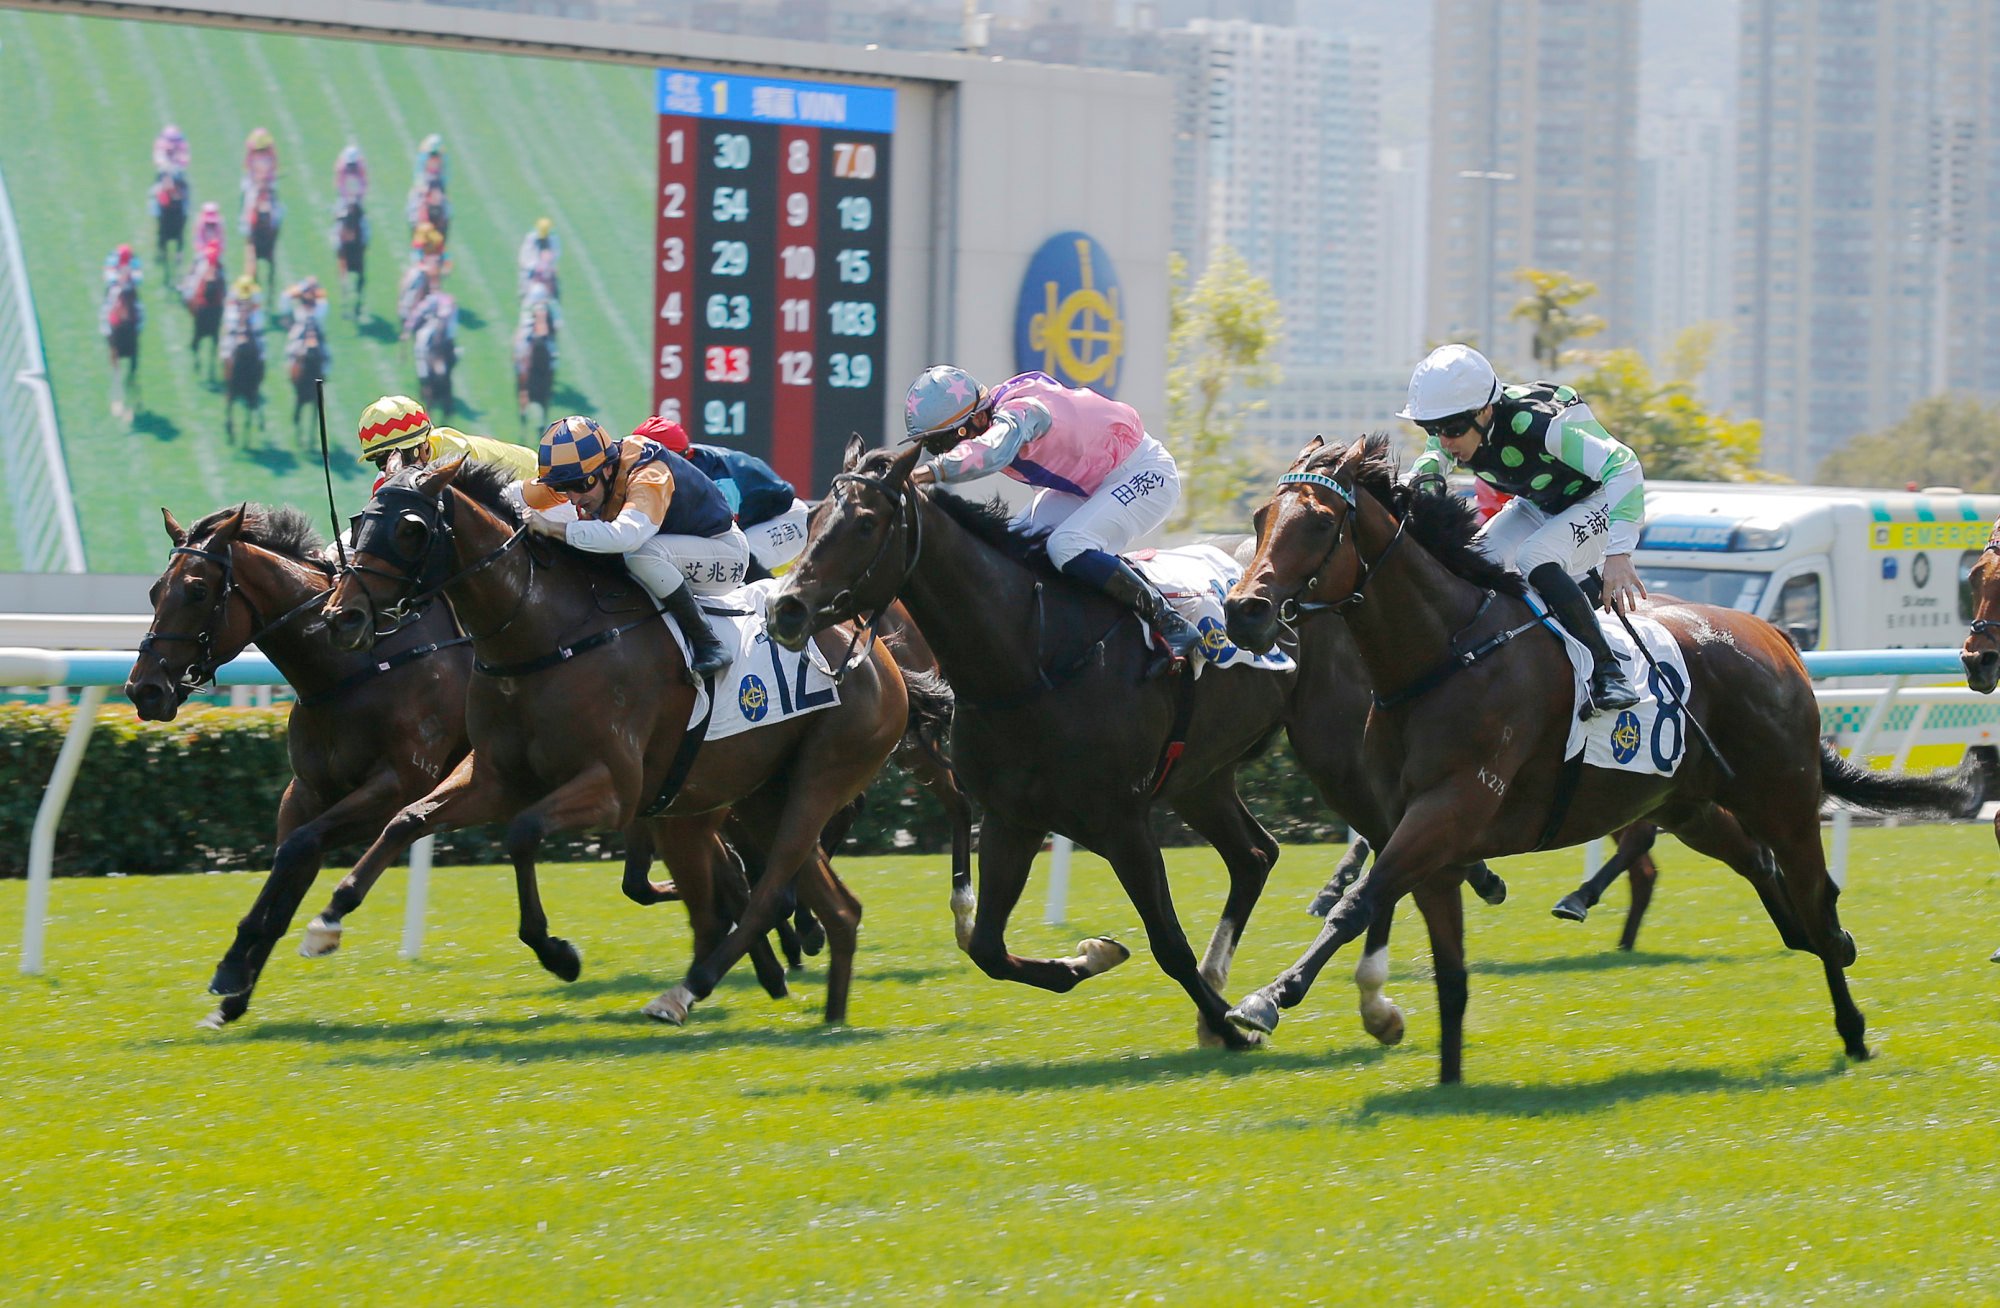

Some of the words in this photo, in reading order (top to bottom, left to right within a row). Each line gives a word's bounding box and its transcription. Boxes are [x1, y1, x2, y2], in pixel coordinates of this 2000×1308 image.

[712, 80, 728, 115] 1
[798, 91, 847, 123] WIN
[666, 130, 684, 164] 1
[713, 133, 751, 169] 30
[787, 139, 810, 174] 8
[663, 183, 686, 218] 2
[712, 186, 749, 222] 54
[786, 192, 809, 227] 9
[837, 196, 872, 231] 19
[662, 237, 685, 272] 3
[711, 240, 748, 276] 29
[780, 245, 815, 280] 10
[836, 249, 871, 284] 15
[660, 292, 683, 326] 4
[780, 298, 810, 332] 11
[828, 301, 876, 336] 183
[660, 345, 682, 380] 5
[778, 351, 813, 386] 12
[1648, 661, 1685, 772] 8
[412, 751, 439, 779] L142
